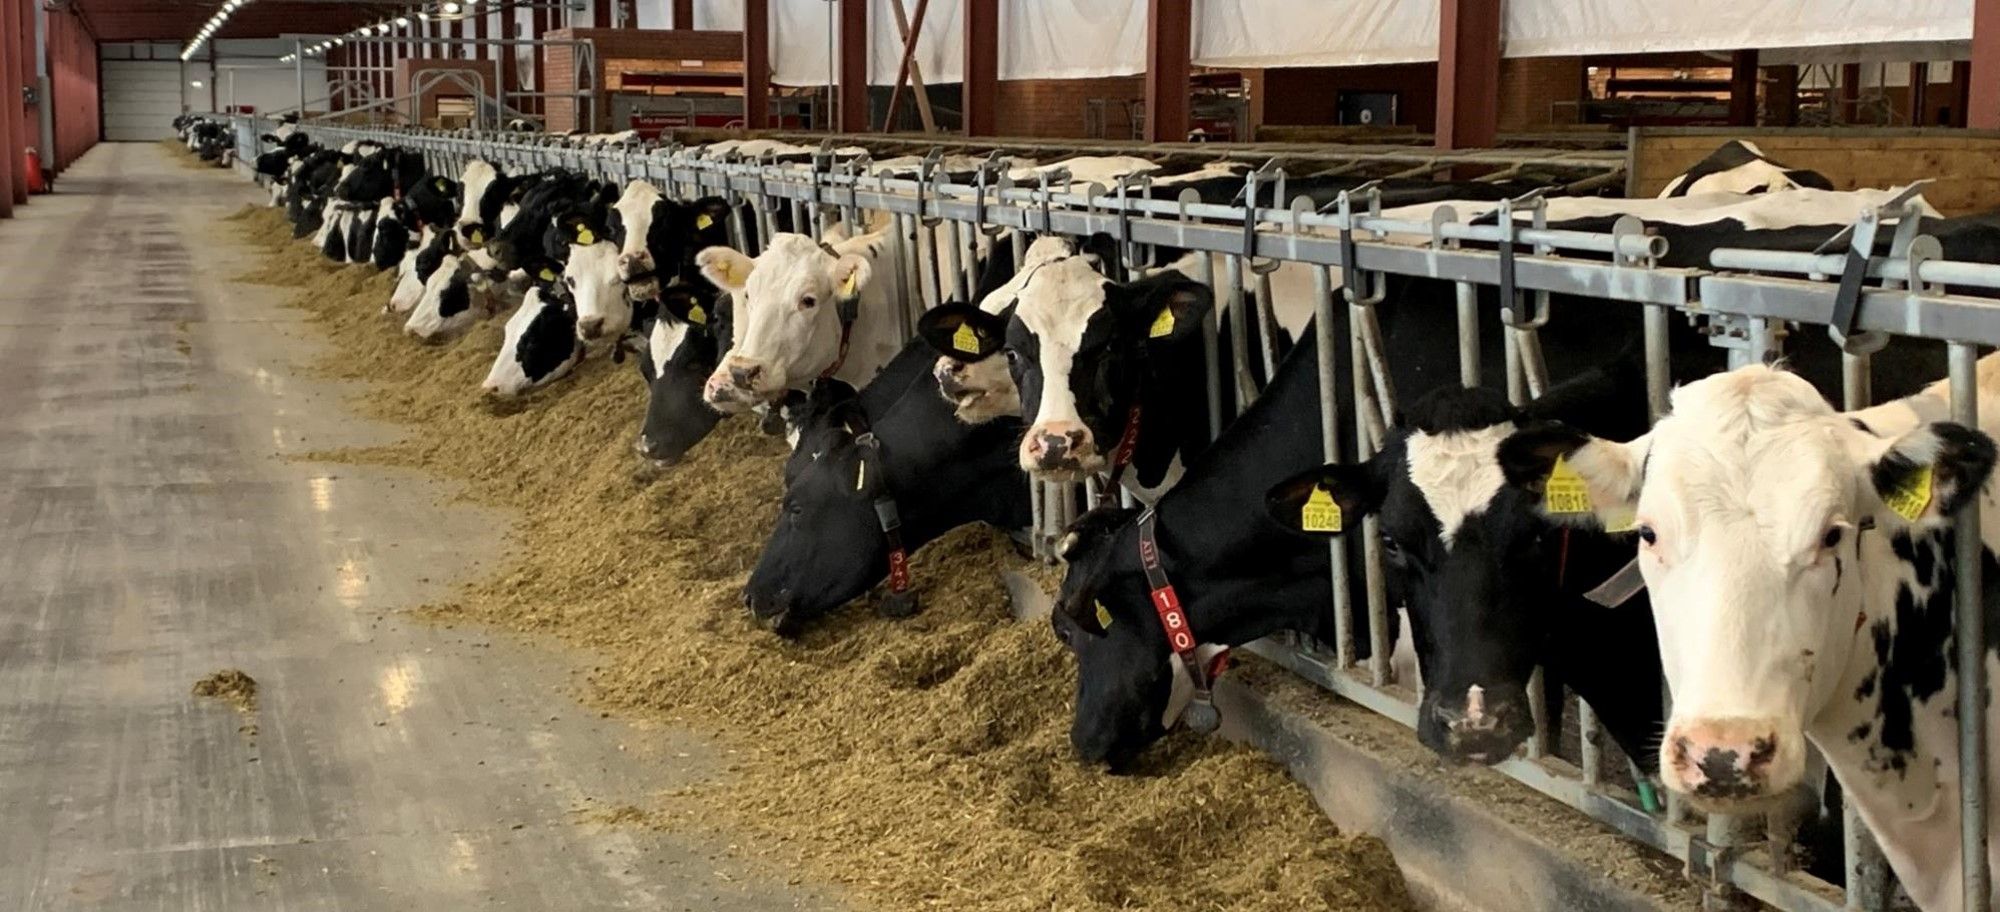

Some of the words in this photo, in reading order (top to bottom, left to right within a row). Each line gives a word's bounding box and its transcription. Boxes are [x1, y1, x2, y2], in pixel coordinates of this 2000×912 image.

[1121, 407, 1141, 465] 222
[1304, 513, 1340, 530] 10248
[893, 551, 906, 590] 342
[1160, 591, 1189, 648] 180
